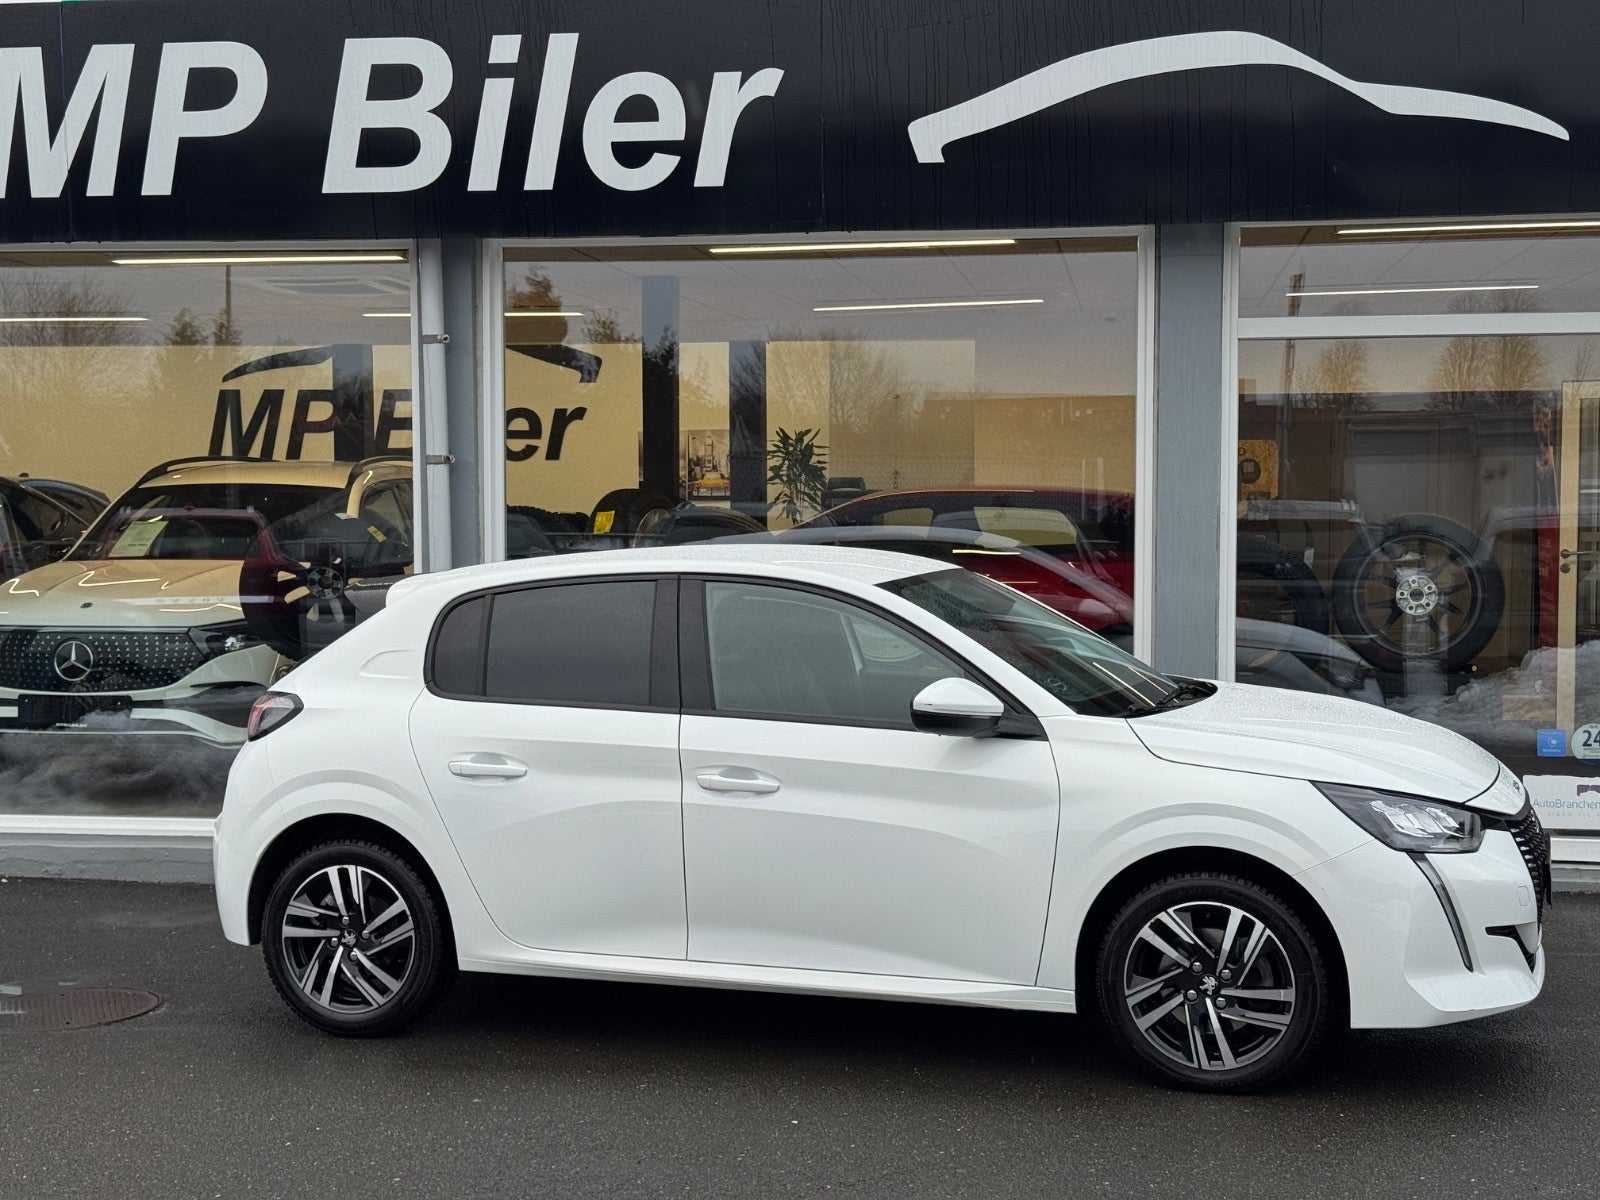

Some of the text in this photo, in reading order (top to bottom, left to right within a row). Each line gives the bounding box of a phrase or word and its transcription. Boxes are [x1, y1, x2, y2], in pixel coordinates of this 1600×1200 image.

[0, 32, 785, 198] MP Biler
[208, 389, 346, 460] MP
